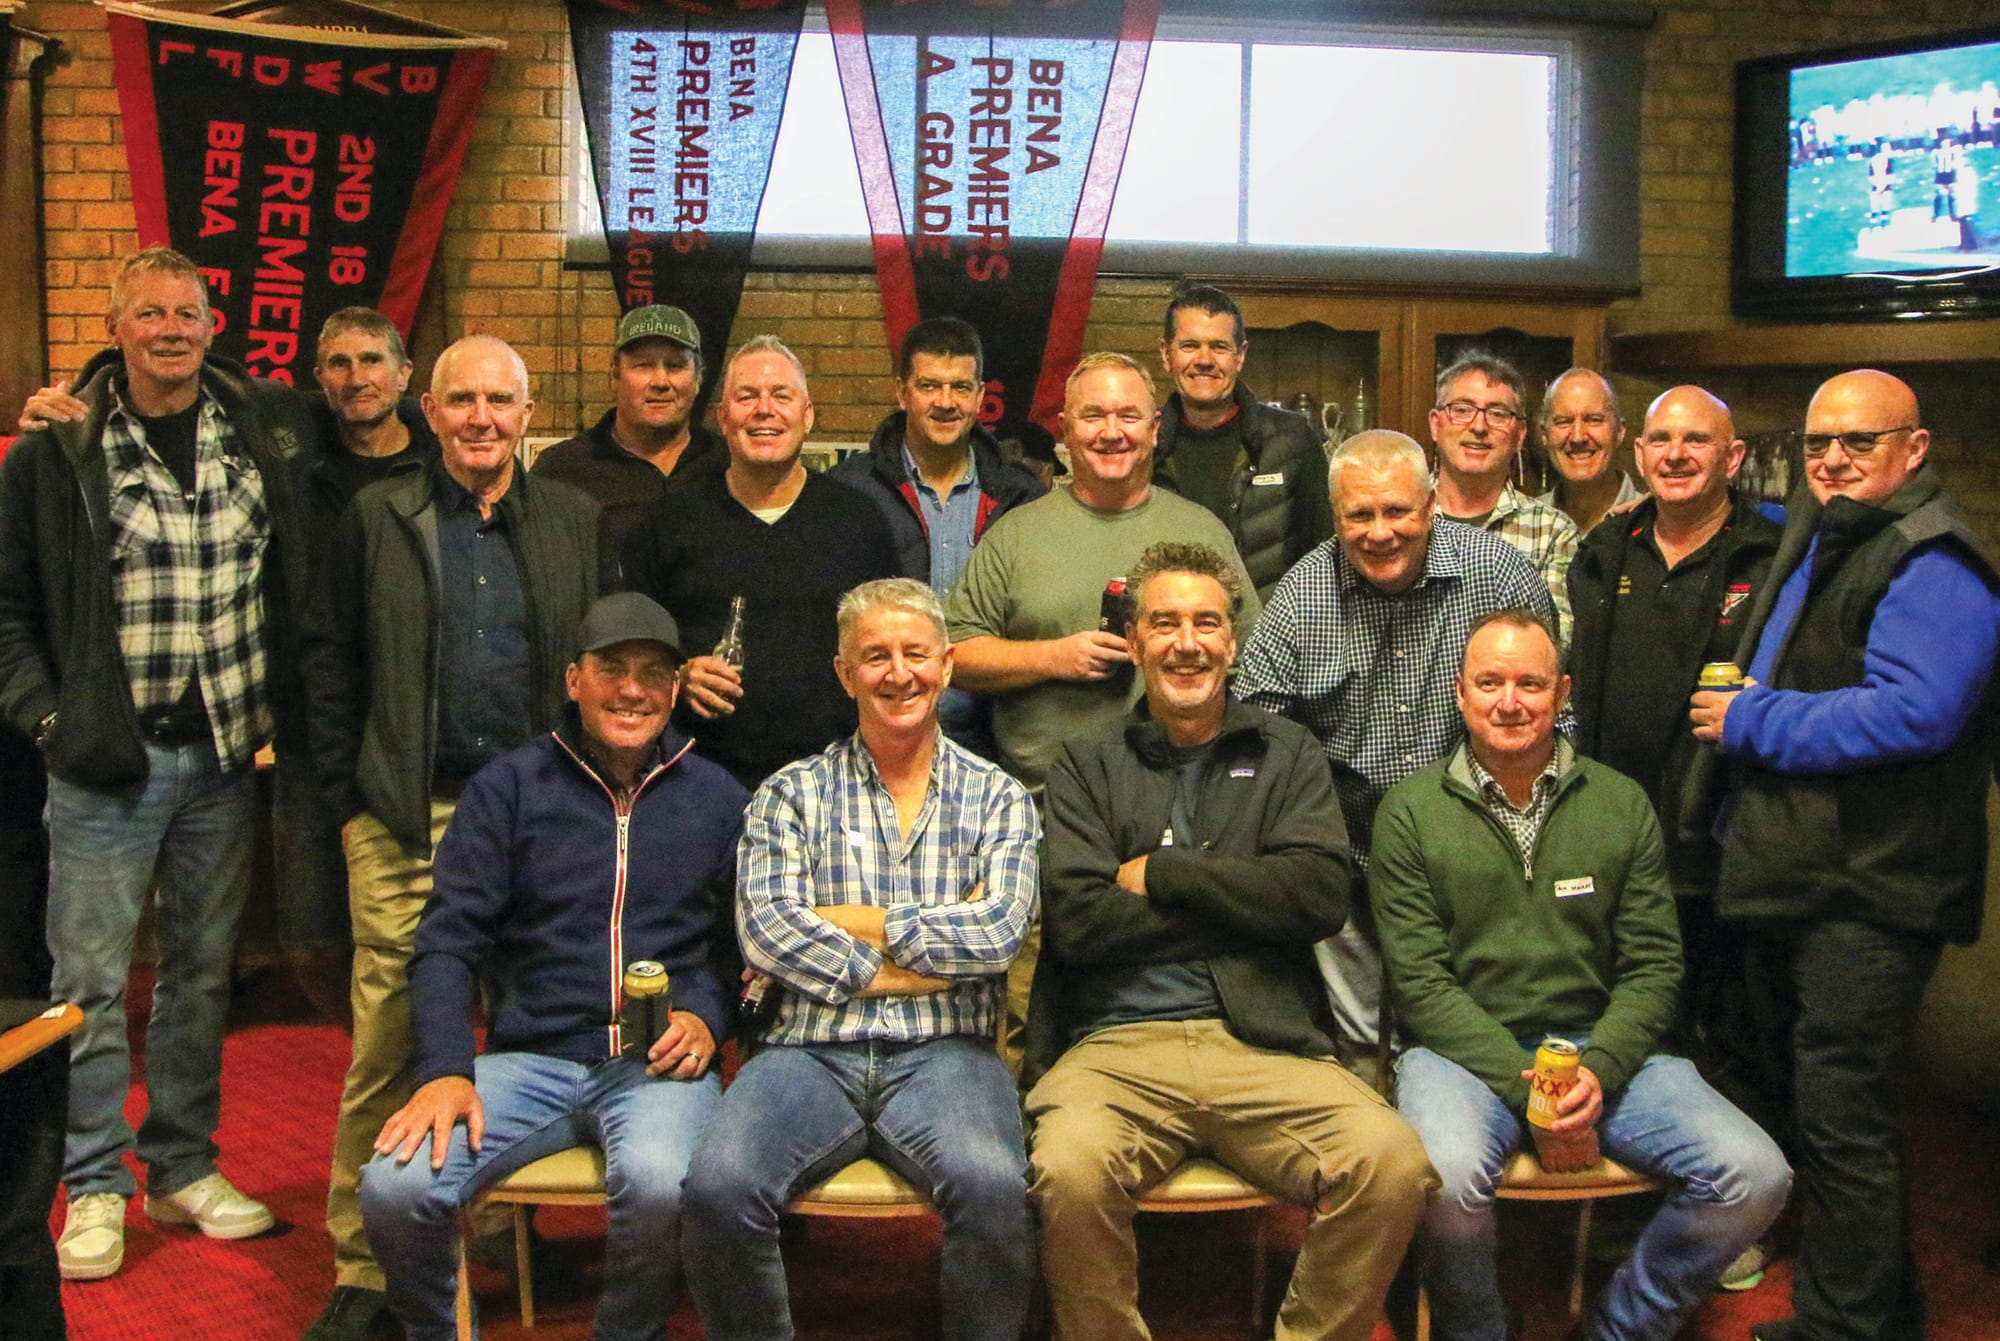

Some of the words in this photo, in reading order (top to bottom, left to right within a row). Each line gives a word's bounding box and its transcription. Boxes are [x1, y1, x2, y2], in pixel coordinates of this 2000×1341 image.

[630, 38, 657, 93] 4TH
[729, 37, 756, 121] BENA
[918, 51, 956, 81] A
[629, 106, 656, 173] XVIII
[672, 40, 711, 253] PREMIERS
[1025, 59, 1065, 174] BENA
[198, 120, 245, 238] BENA
[334, 134, 376, 223] 2ND
[915, 112, 955, 259] GRADE
[966, 57, 1014, 282] PREMIERS
[328, 246, 368, 285] 18
[629, 322, 682, 336] IRELAND
